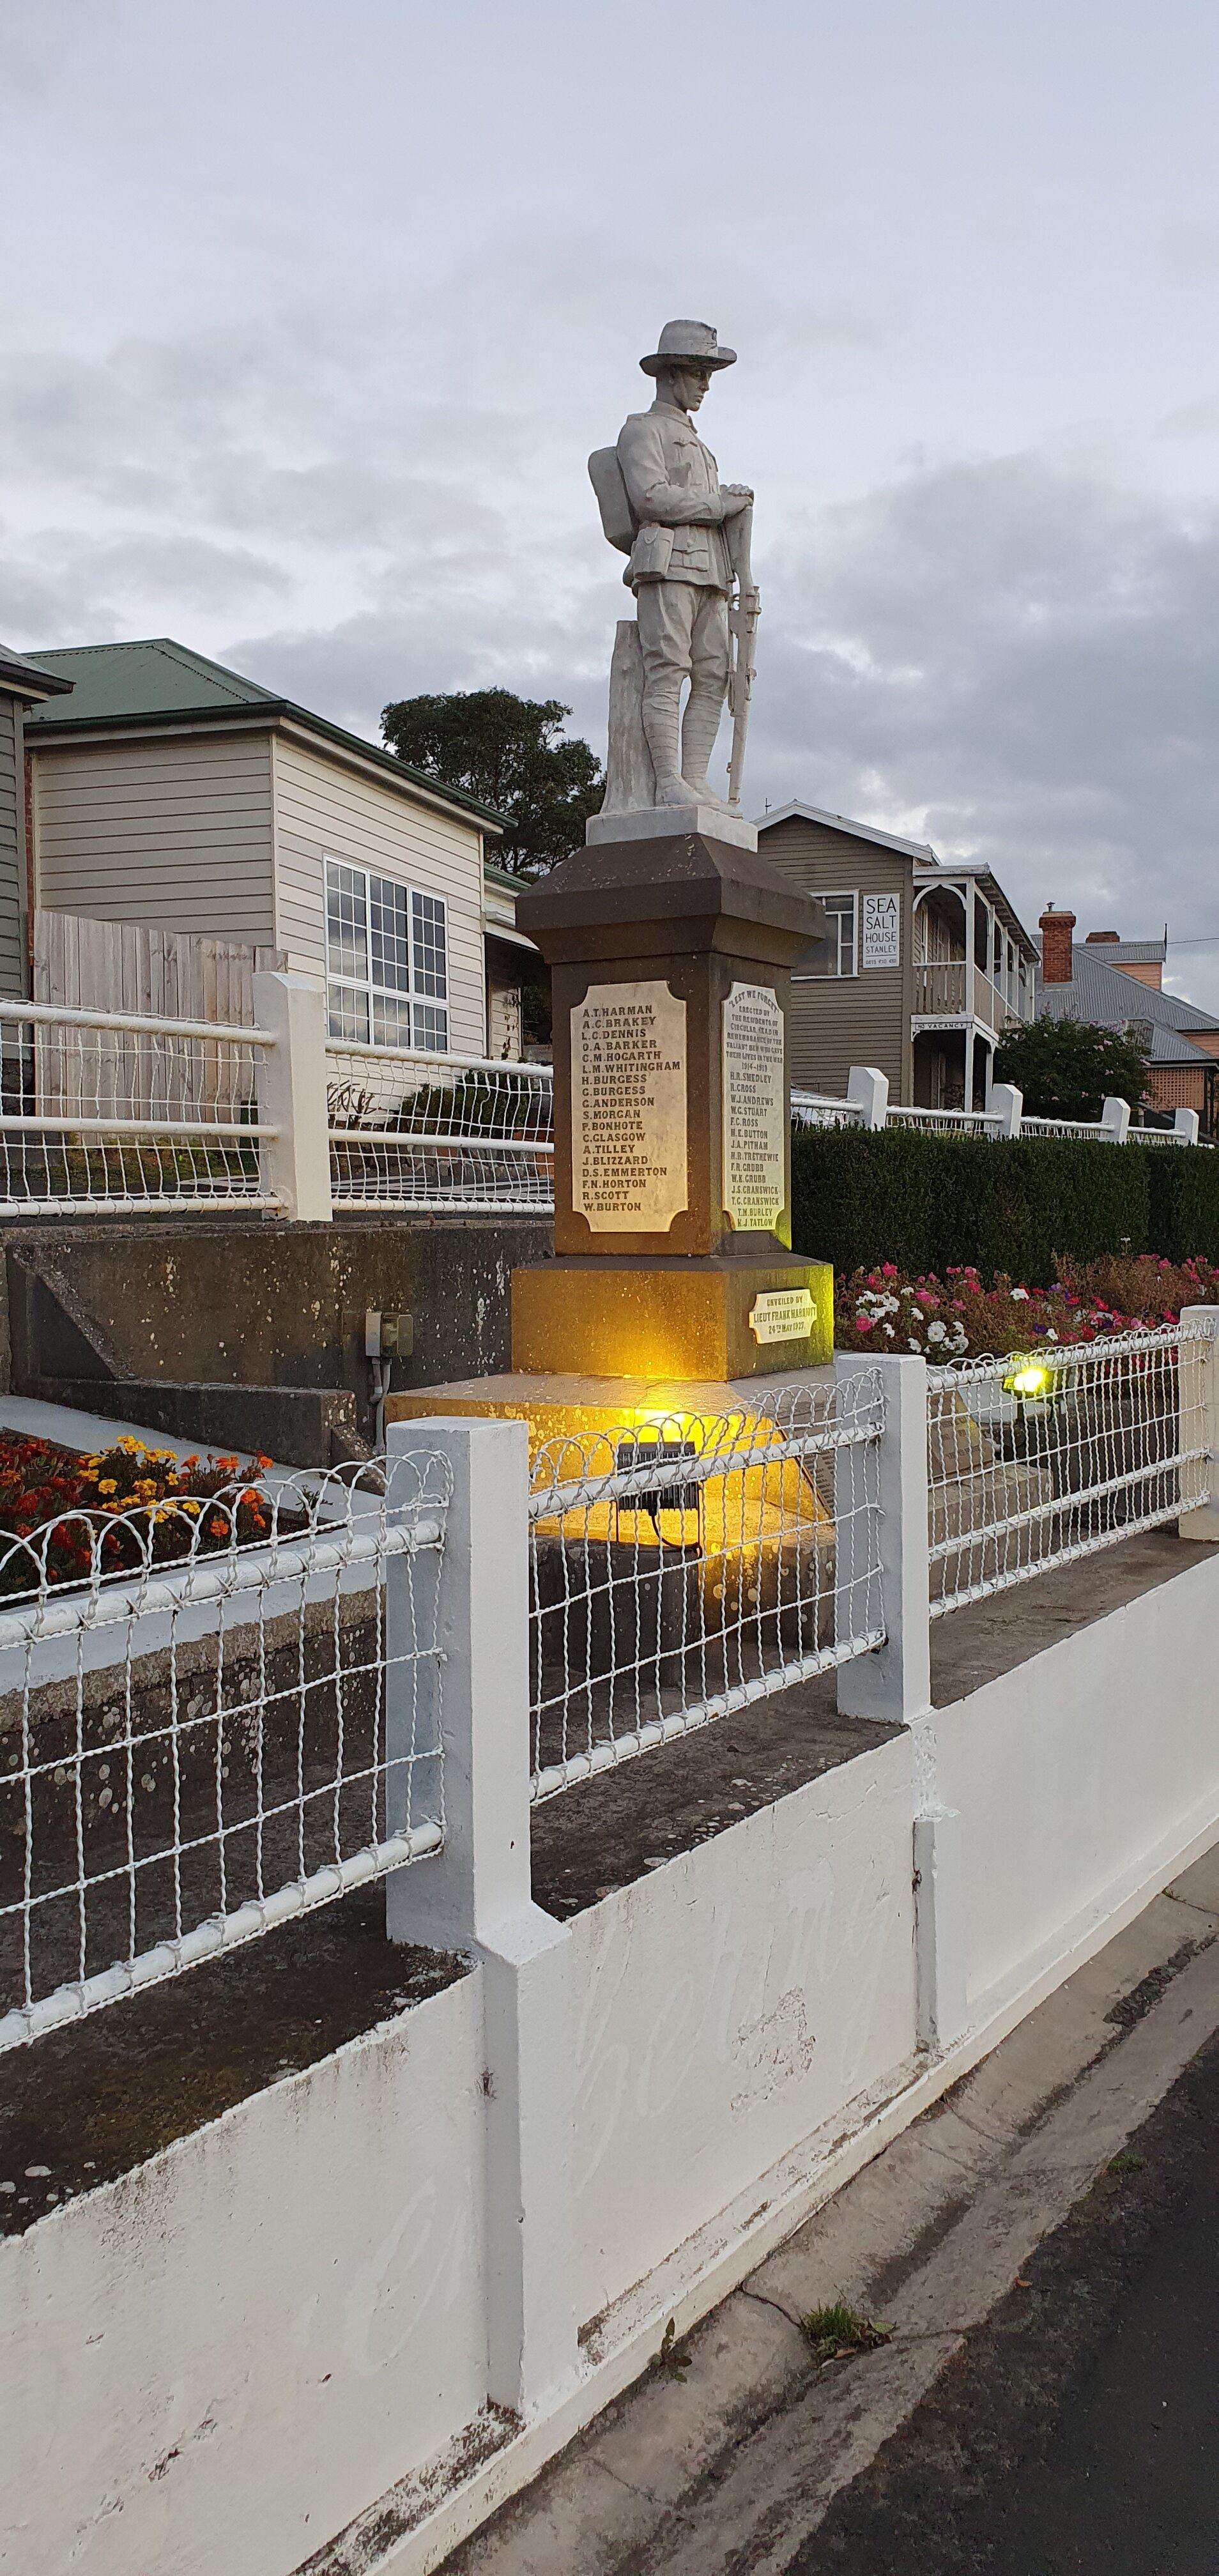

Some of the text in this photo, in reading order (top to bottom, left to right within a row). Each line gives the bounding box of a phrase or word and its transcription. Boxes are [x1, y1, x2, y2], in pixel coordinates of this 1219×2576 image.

[866, 897, 896, 914] SEA
[866, 916, 896, 930] SALT
[866, 931, 896, 943] HOUSE
[583, 1005, 652, 1018] A.T.HARMAN
[739, 1006, 762, 1015] ERECTED
[582, 1016, 656, 1029] A.C.BRAKEY
[743, 1015, 771, 1026] RESIDENTS
[730, 1022, 756, 1033] CIRCULAR
[581, 1029, 646, 1040] L.C.DENNIS
[727, 1032, 766, 1043] REMEMBRANCE
[726, 1041, 747, 1050] VALIANT
[726, 1050, 741, 1059] THEIR
[581, 1074, 647, 1085] H.BURGESS
[730, 1083, 756, 1093] R.CROSS
[583, 1110, 641, 1120] S.MORGAN
[582, 1121, 643, 1131] P.BONHOTE
[583, 1132, 646, 1142] C.GLASGOW
[583, 1144, 636, 1154] A.TILLEY
[582, 1156, 648, 1166] J.BLIZZARD
[582, 1167, 668, 1177] D.S.EMMERTON
[582, 1179, 647, 1189] F.N.HORTON
[582, 1191, 629, 1200] R.SCOTT
[583, 1202, 641, 1211] W.BURTON
[767, 1296, 794, 1307] UNVEILED
[754, 1307, 816, 1323] LIEUT FRANK MARRIOTT
